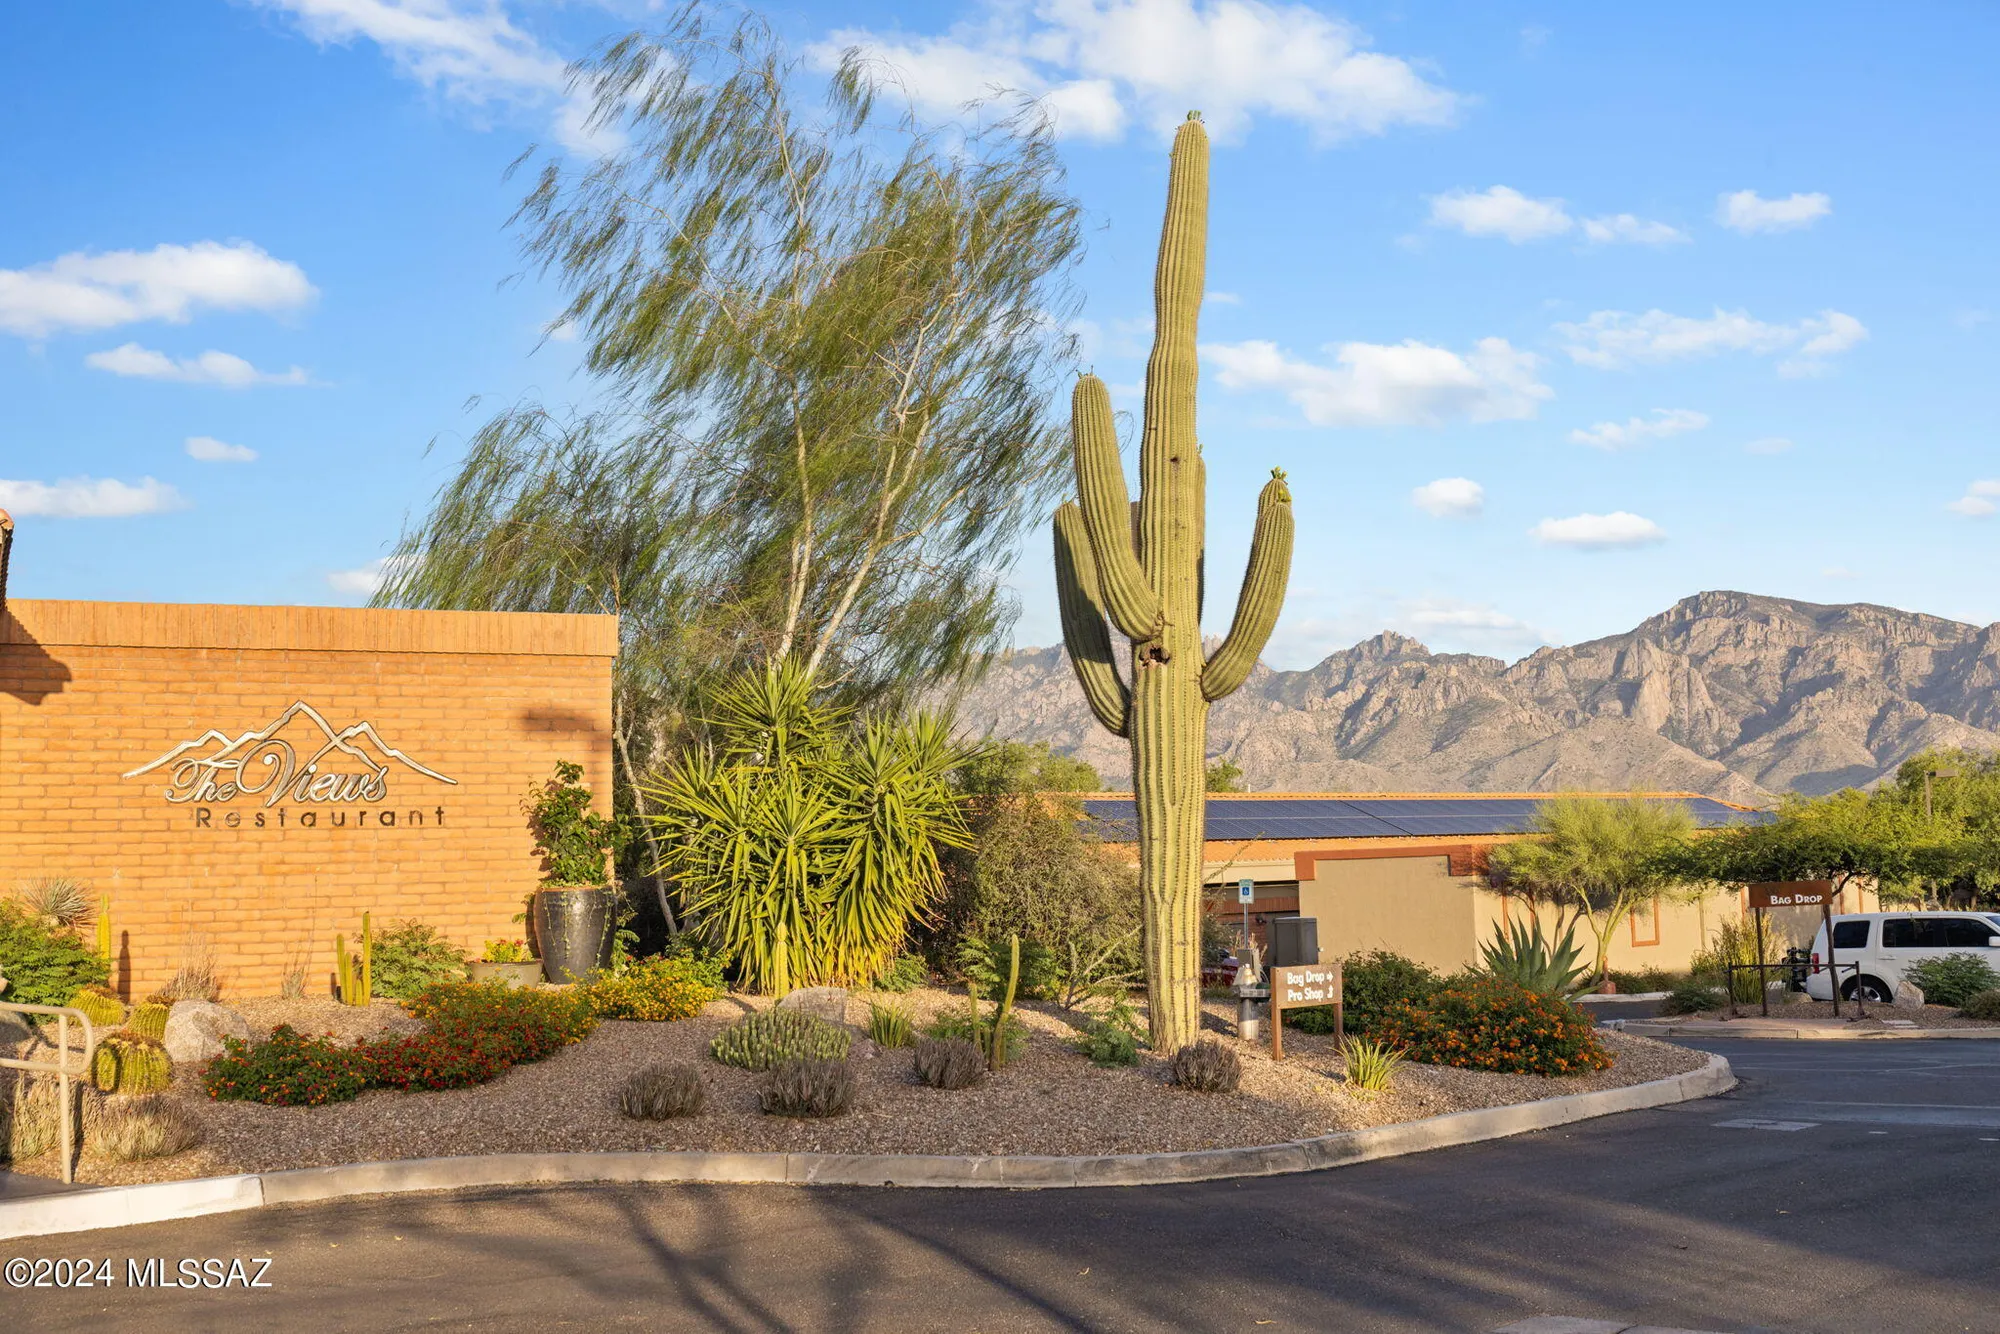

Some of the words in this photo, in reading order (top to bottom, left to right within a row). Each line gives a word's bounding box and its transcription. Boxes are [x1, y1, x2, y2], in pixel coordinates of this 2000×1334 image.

[164, 757, 240, 804] The
[235, 739, 389, 808] Views
[195, 806, 445, 828] Restaurant
[1770, 895, 1792, 905] BAG
[1794, 893, 1823, 904] DROP
[1287, 971, 1304, 987] Bag
[1305, 970, 1325, 985] Drop
[1287, 988, 1303, 1002] Pro
[1304, 987, 1324, 1002] Shop
